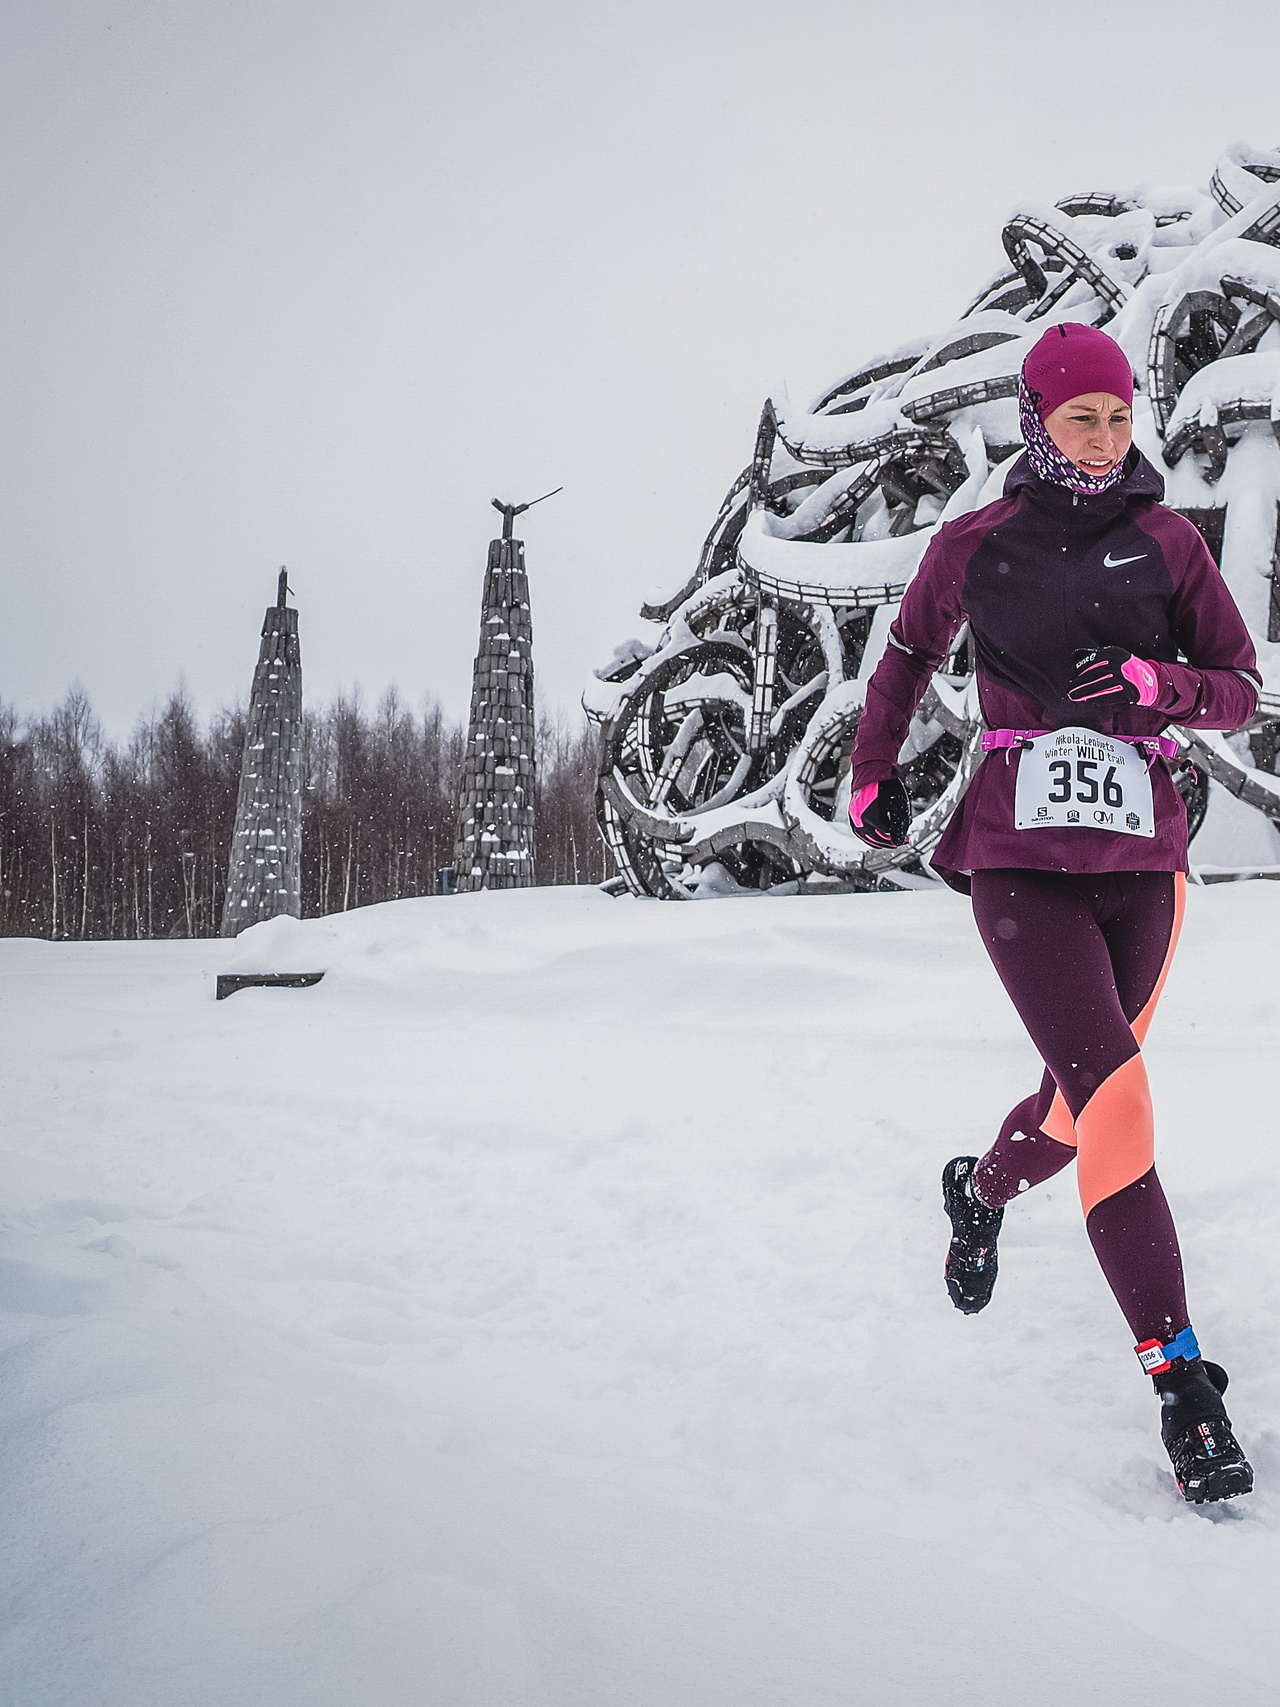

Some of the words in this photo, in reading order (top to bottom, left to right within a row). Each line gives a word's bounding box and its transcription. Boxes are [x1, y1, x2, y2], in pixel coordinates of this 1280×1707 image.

[1055, 733, 1115, 752] Nikola-Lenivets
[1044, 747, 1073, 759] Winter
[1076, 745, 1105, 761] WILD
[1107, 752, 1126, 765] trail
[1048, 760, 1123, 808] 356
